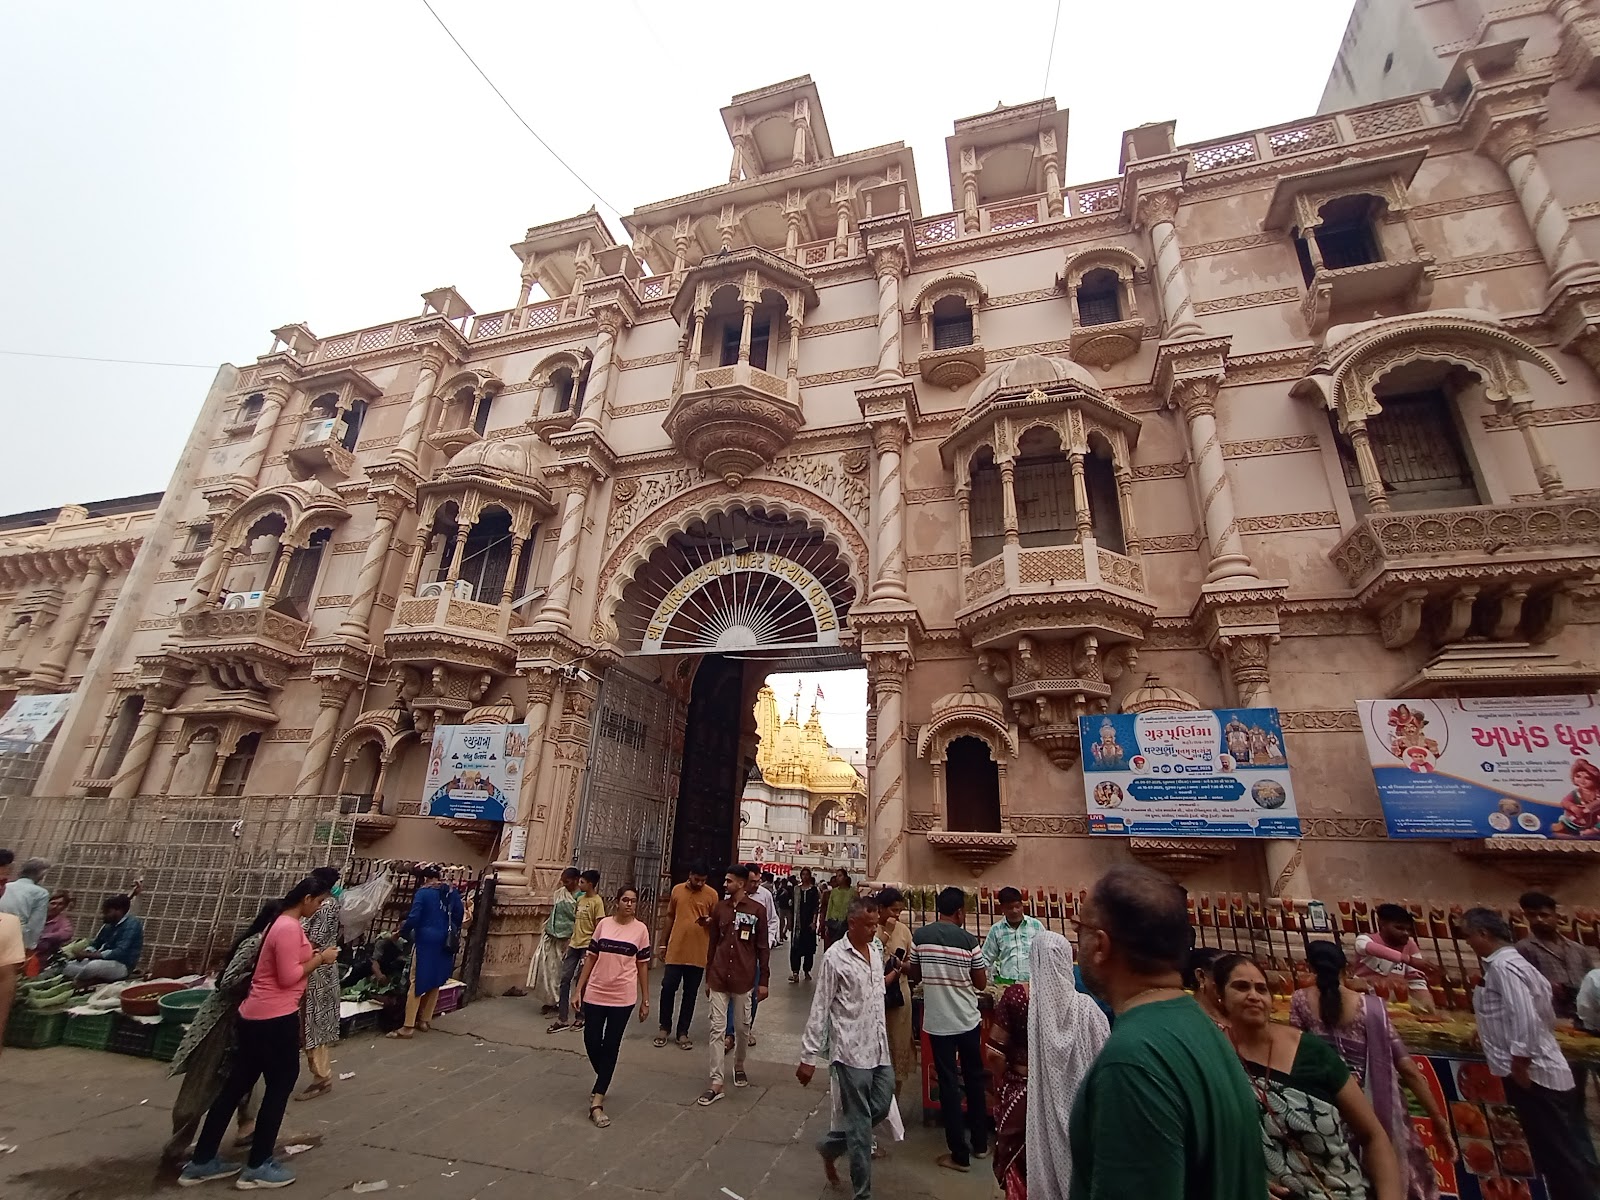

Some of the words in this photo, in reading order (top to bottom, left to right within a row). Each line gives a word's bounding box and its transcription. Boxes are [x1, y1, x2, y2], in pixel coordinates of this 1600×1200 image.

[655, 558, 731, 623] સ્વામિનારાયણ
[808, 585, 836, 632] વડતાલ
[648, 625, 664, 641] શ્રી
[1471, 720, 1549, 757] અખંડ
[1554, 723, 1600, 756] ધૂન
